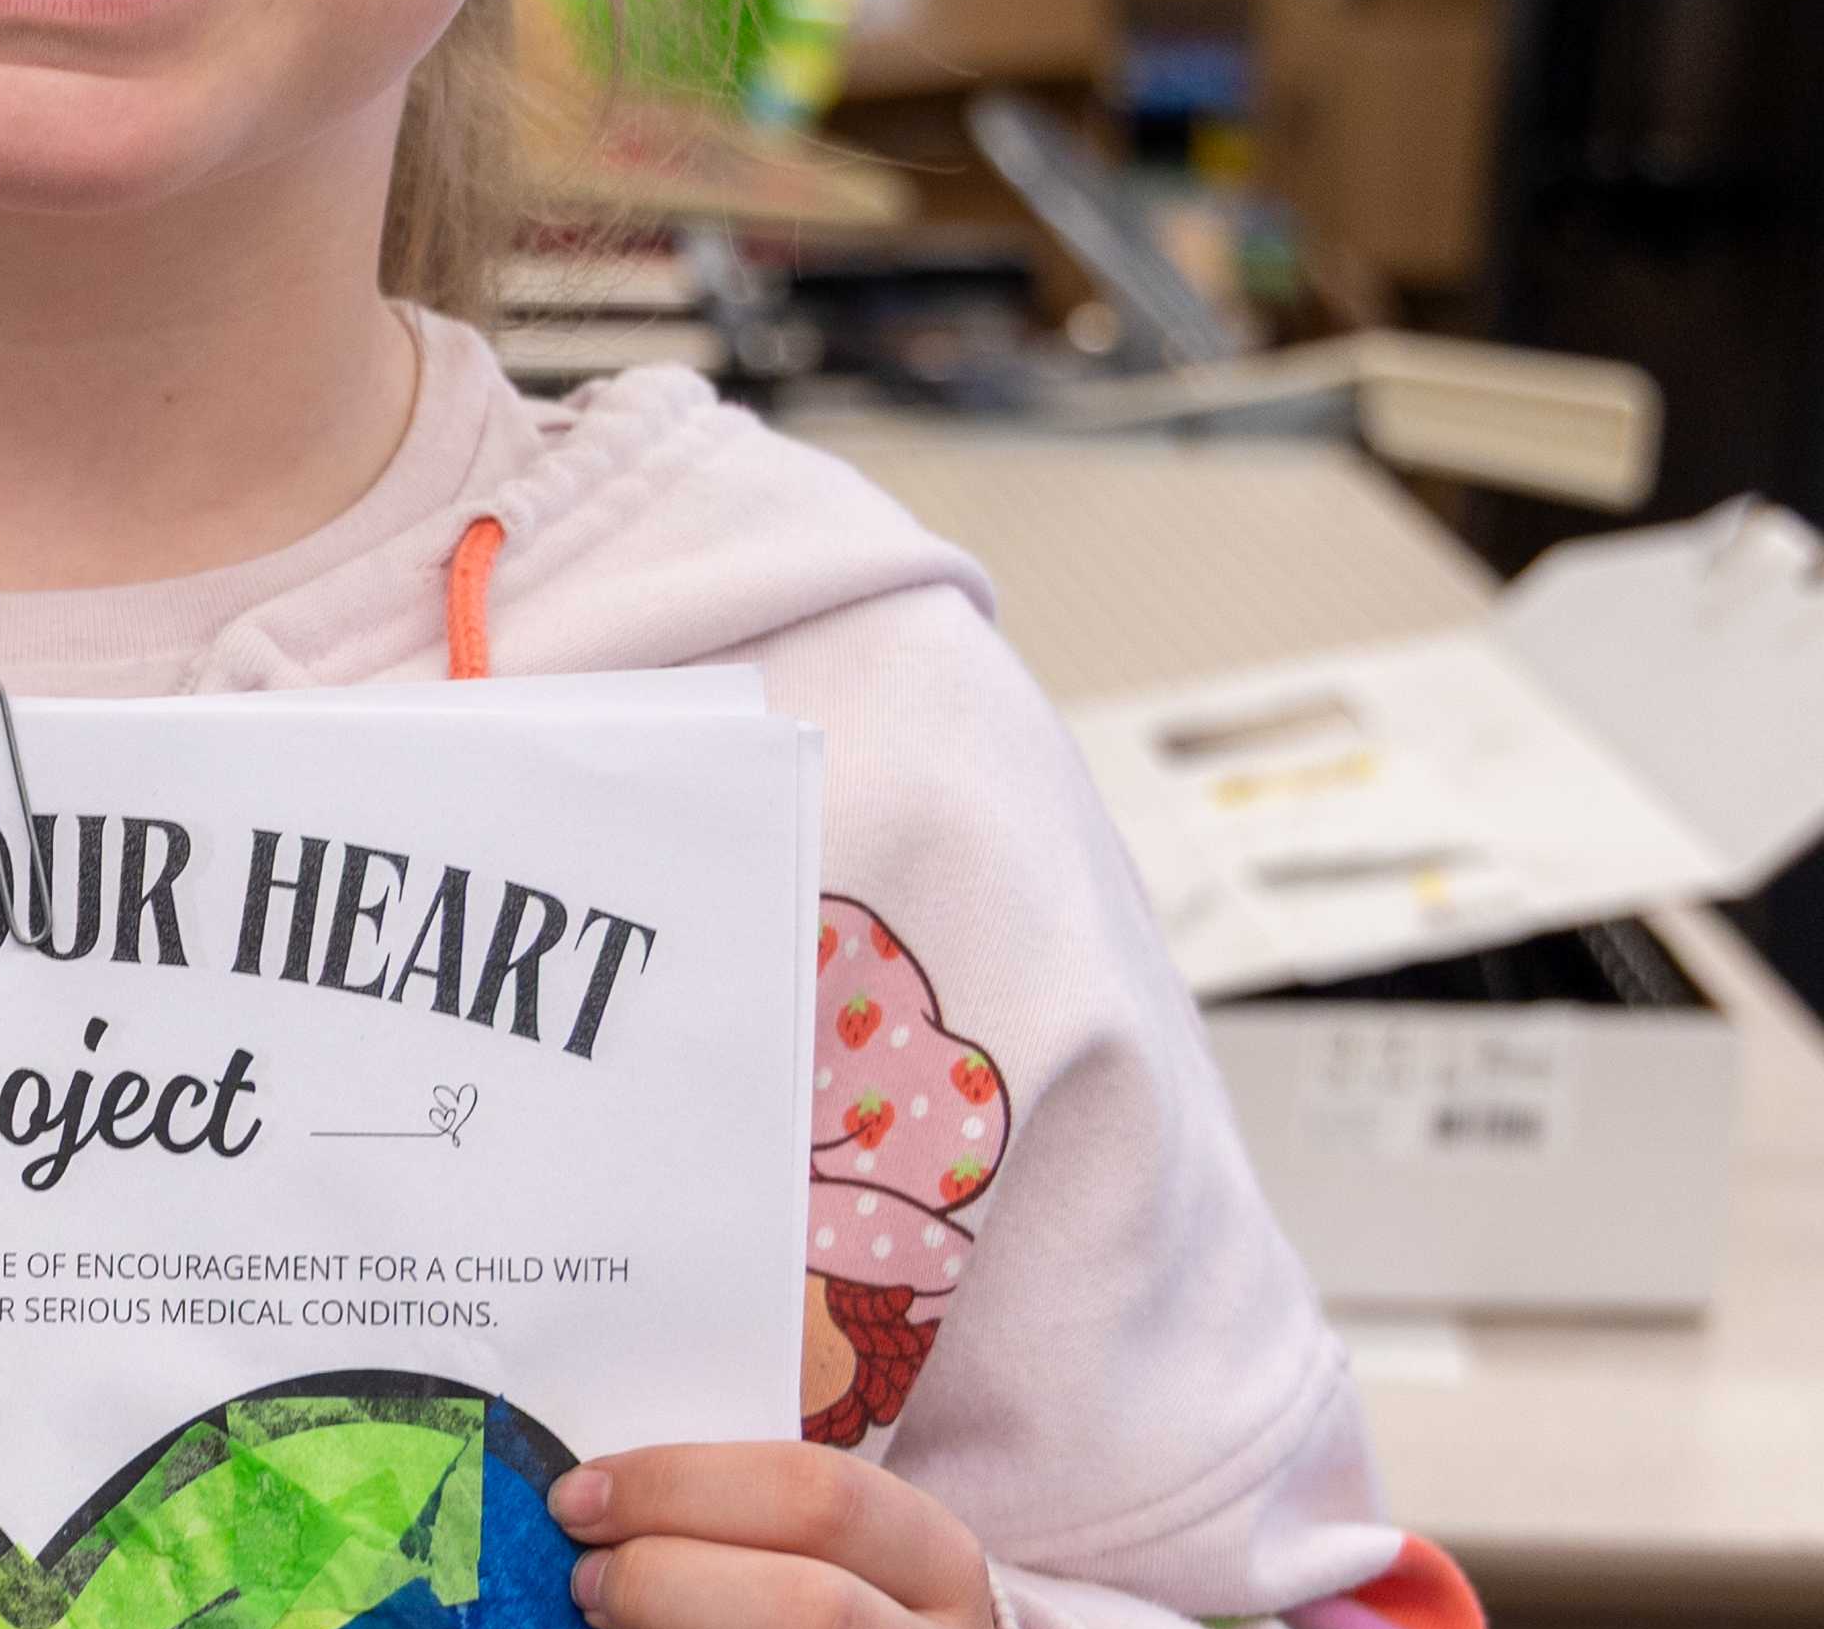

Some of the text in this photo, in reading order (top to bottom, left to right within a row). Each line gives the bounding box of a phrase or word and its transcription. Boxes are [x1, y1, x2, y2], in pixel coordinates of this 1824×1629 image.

[231, 828, 659, 1062] HEART
[26, 1252, 66, 1279] OF
[76, 1253, 350, 1282] ENCOURAGEMENT
[359, 1255, 417, 1283] FOR
[425, 1256, 446, 1283] A
[455, 1256, 544, 1283] CHILD
[553, 1257, 629, 1283] WITH
[24, 1297, 151, 1324] SERIOUS
[161, 1298, 293, 1326] MEDICAL
[302, 1299, 498, 1328] CONDITIONS.
